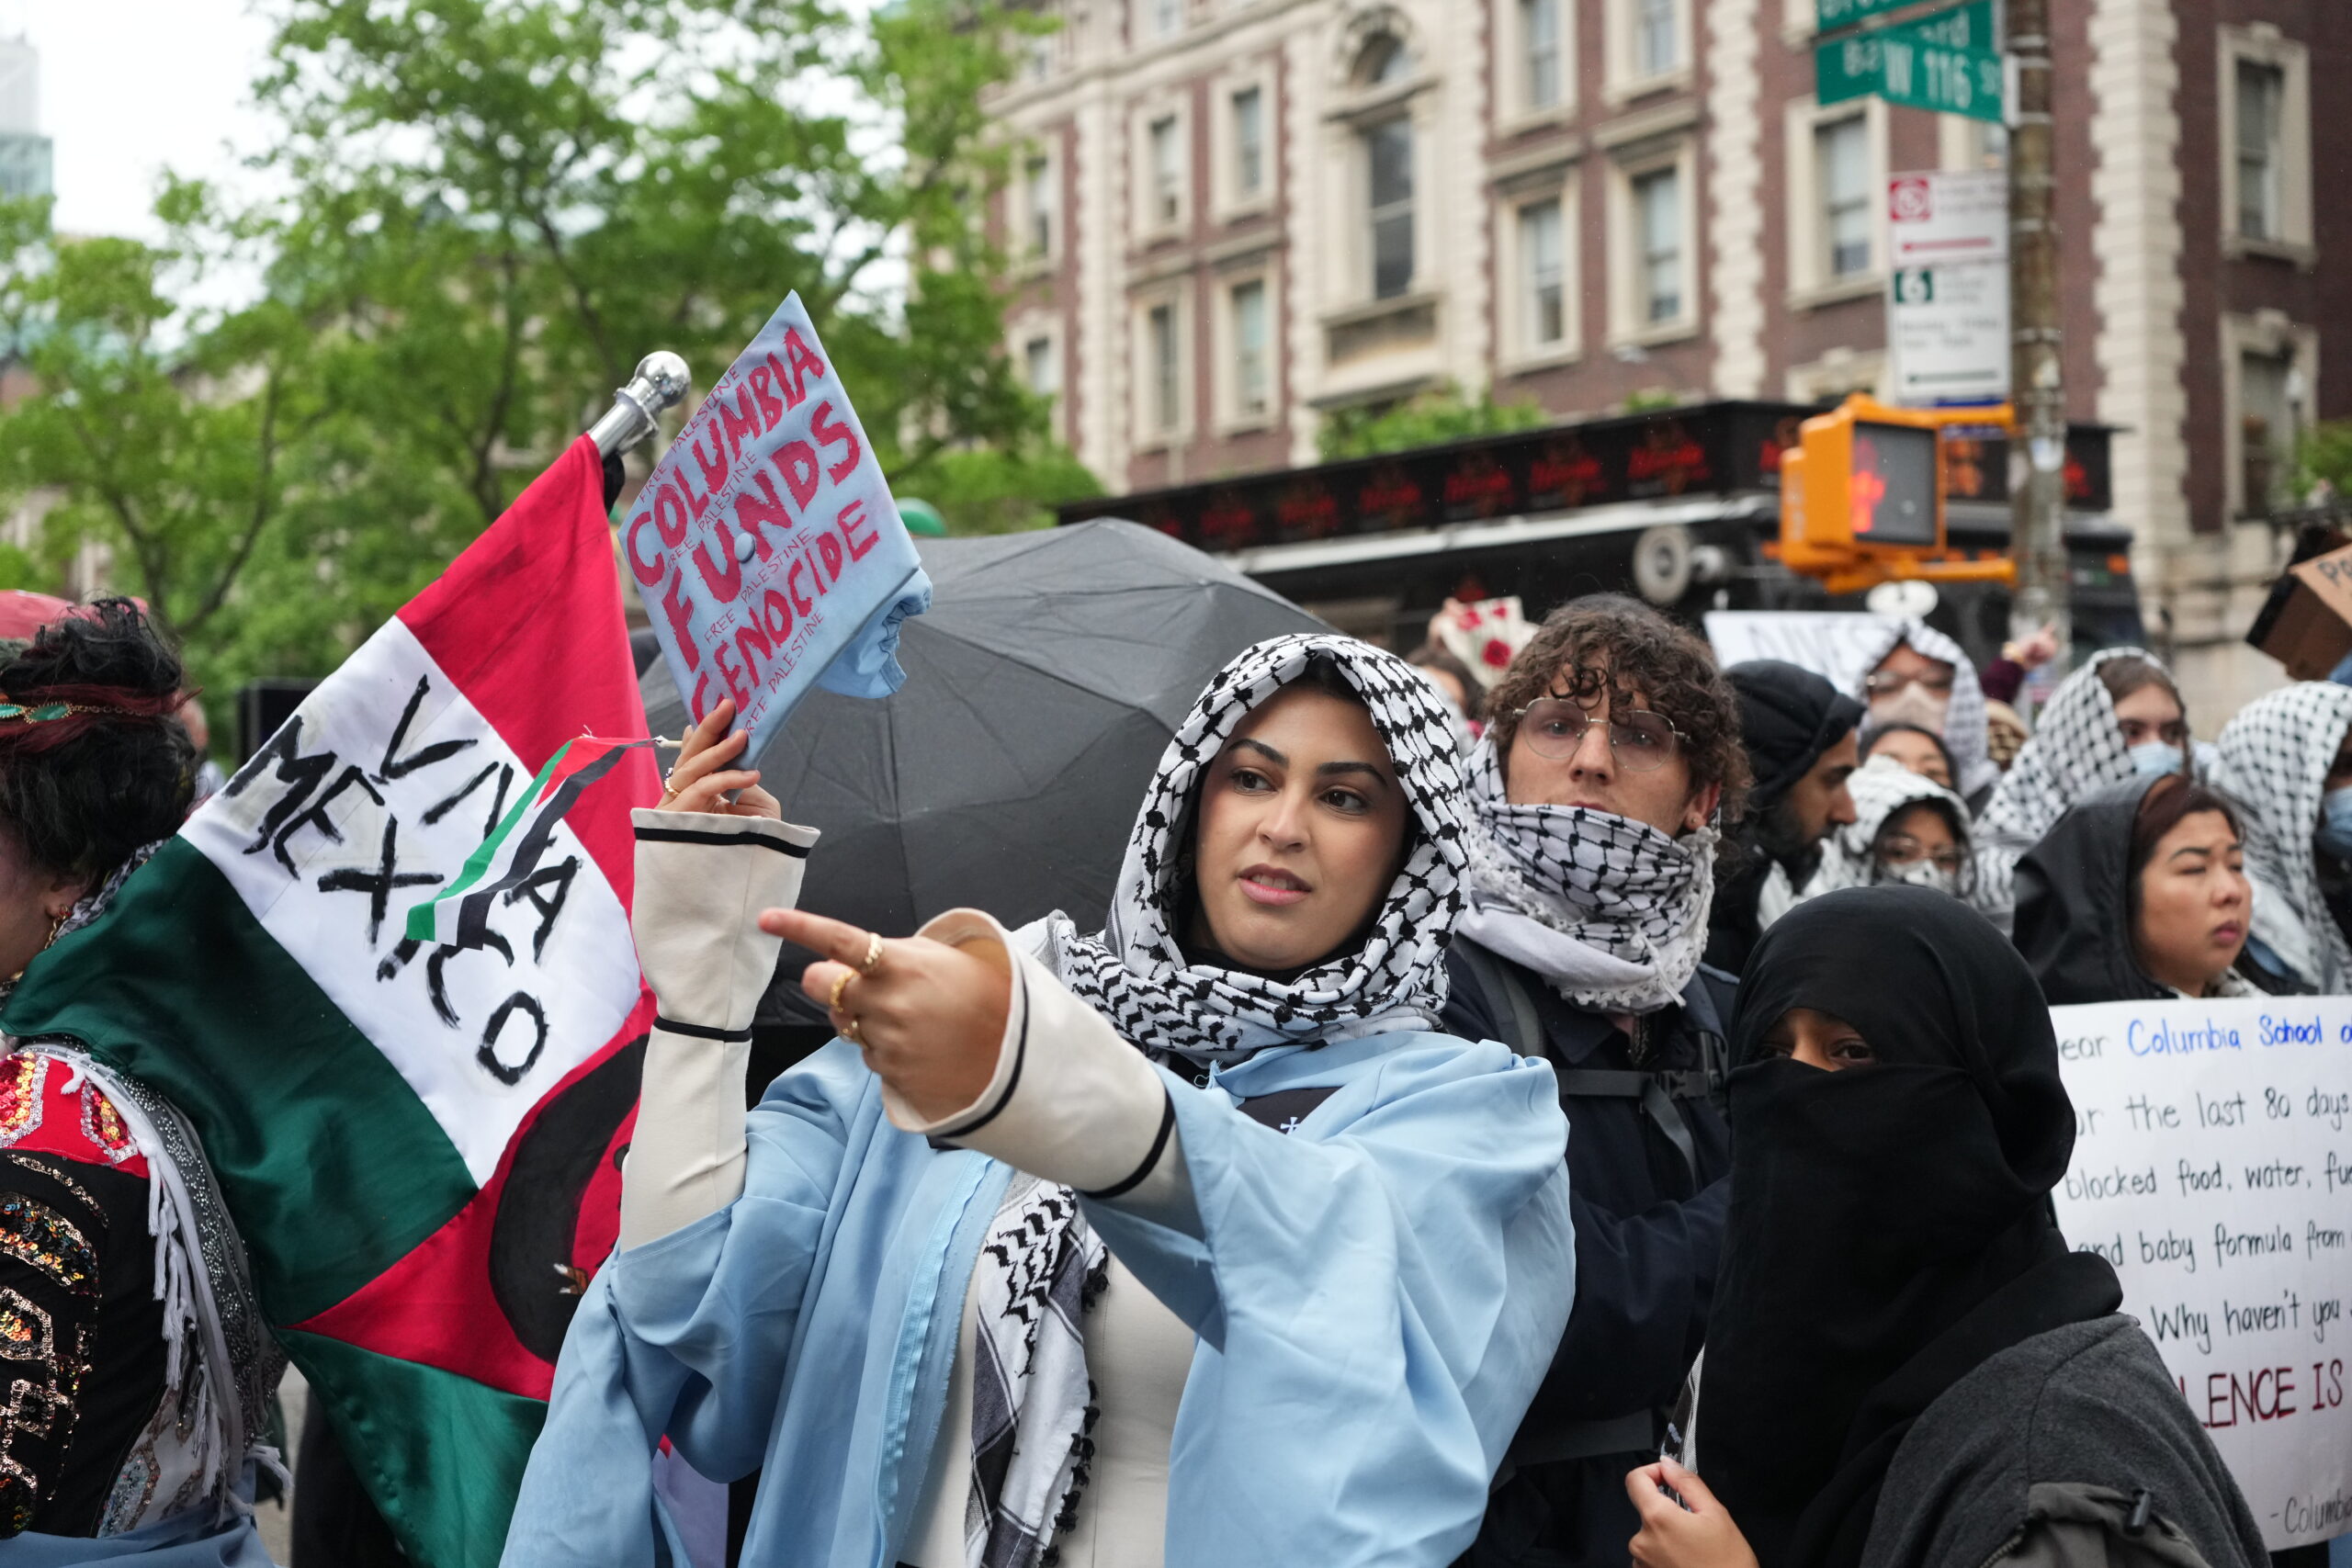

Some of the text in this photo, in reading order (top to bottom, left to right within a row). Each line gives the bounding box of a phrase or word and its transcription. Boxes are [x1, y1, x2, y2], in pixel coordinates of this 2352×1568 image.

[1883, 39, 1914, 96] W
[1924, 49, 1973, 109] 116
[627, 325, 825, 590] COLUMBIA
[639, 365, 741, 503] FREE PALESTINE
[661, 400, 862, 673] FUNDS
[667, 450, 757, 571] FREE PALESTINE
[690, 499, 879, 735] GENOCIDE
[703, 525, 816, 646] FREE PALESTINE
[742, 608, 825, 739] REE PALESTINE
[2059, 1033, 2111, 1062] ear
[2127, 1017, 2243, 1057] Columbia
[2258, 1014, 2324, 1046] School
[2125, 1093, 2182, 1132] the
[2196, 1090, 2247, 1129] last
[2264, 1086, 2290, 1120] 80
[2305, 1085, 2350, 1133] days
[2065, 1164, 2158, 1201] blocked
[2177, 1157, 2233, 1198] food,
[2244, 1157, 2312, 1190] water,
[2139, 1229, 2198, 1273] baby
[2213, 1222, 2293, 1269] formula
[2306, 1219, 2346, 1262] from
[2150, 1289, 2340, 1356] Why haven't you
[2178, 1358, 2345, 1428] ENCE IS
